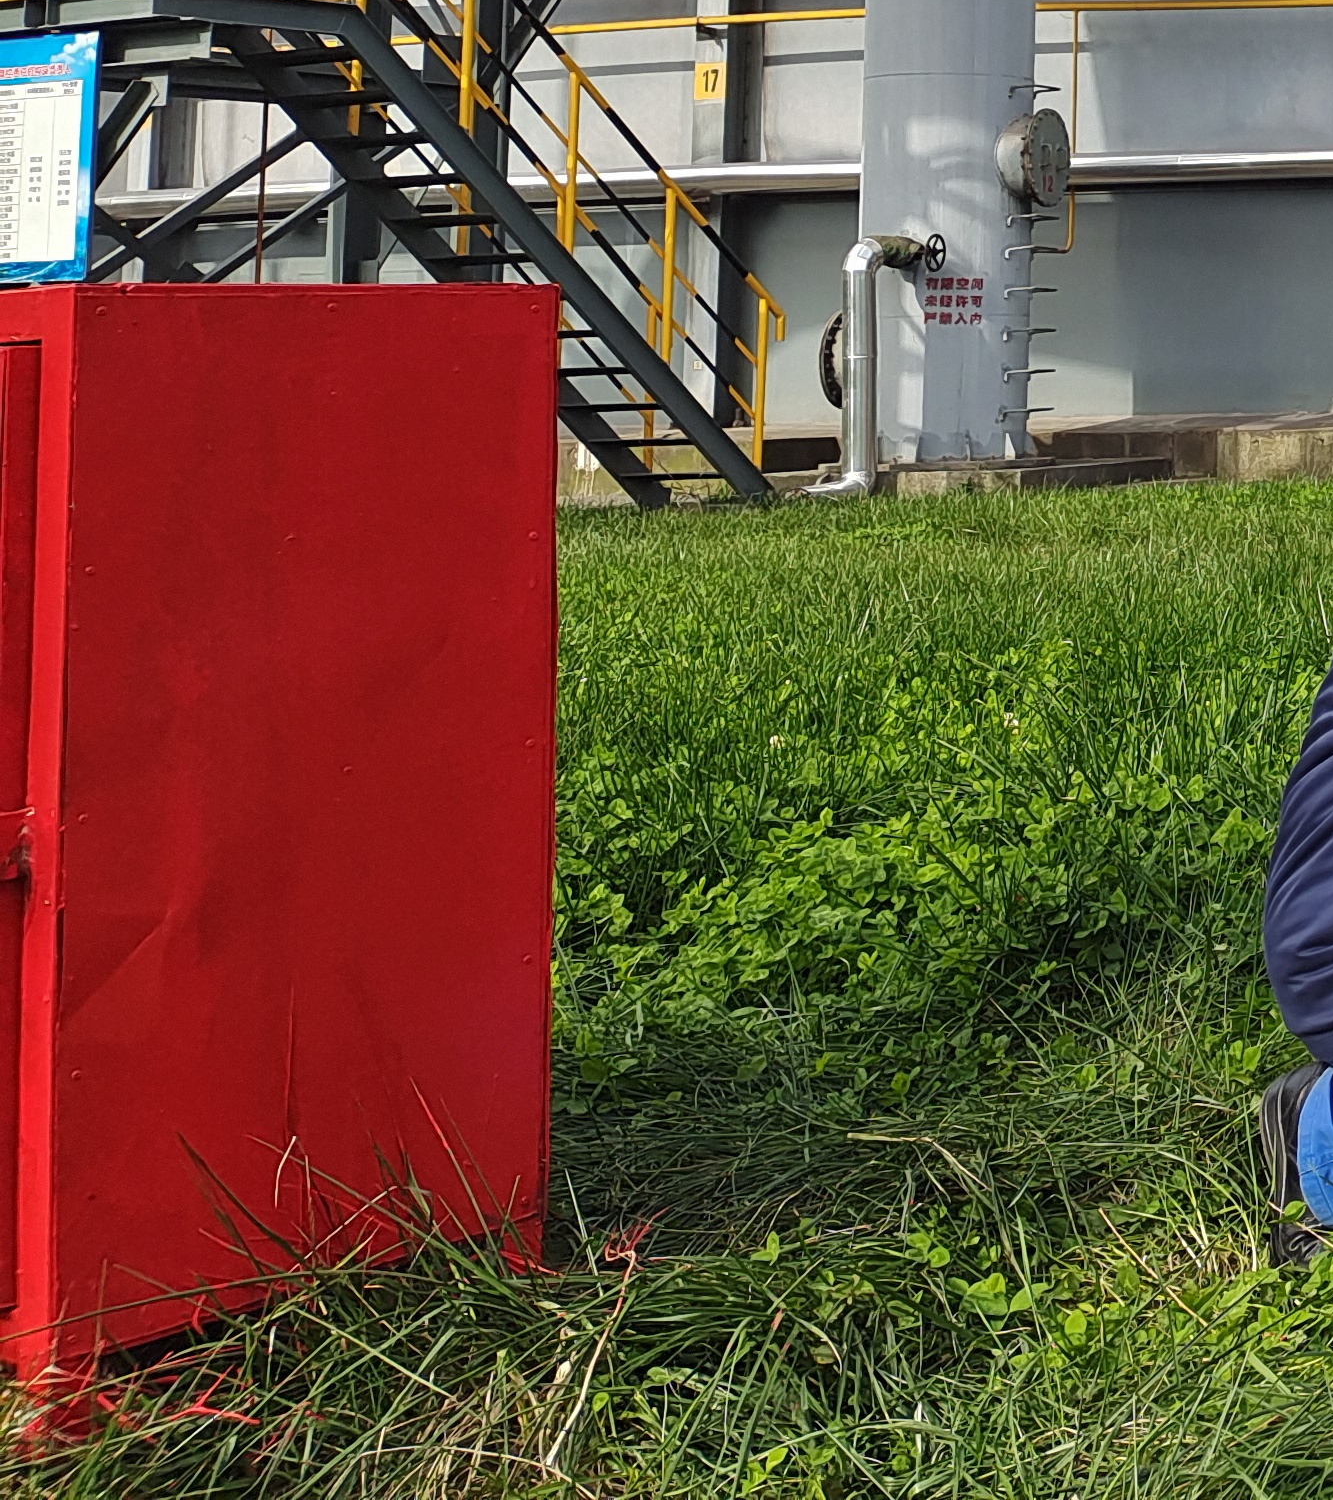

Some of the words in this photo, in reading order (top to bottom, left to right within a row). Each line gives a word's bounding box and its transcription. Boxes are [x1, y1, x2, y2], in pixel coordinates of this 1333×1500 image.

[703, 69, 719, 92] 17
[925, 277, 984, 291] 有限空间
[924, 295, 983, 308] 未经许可
